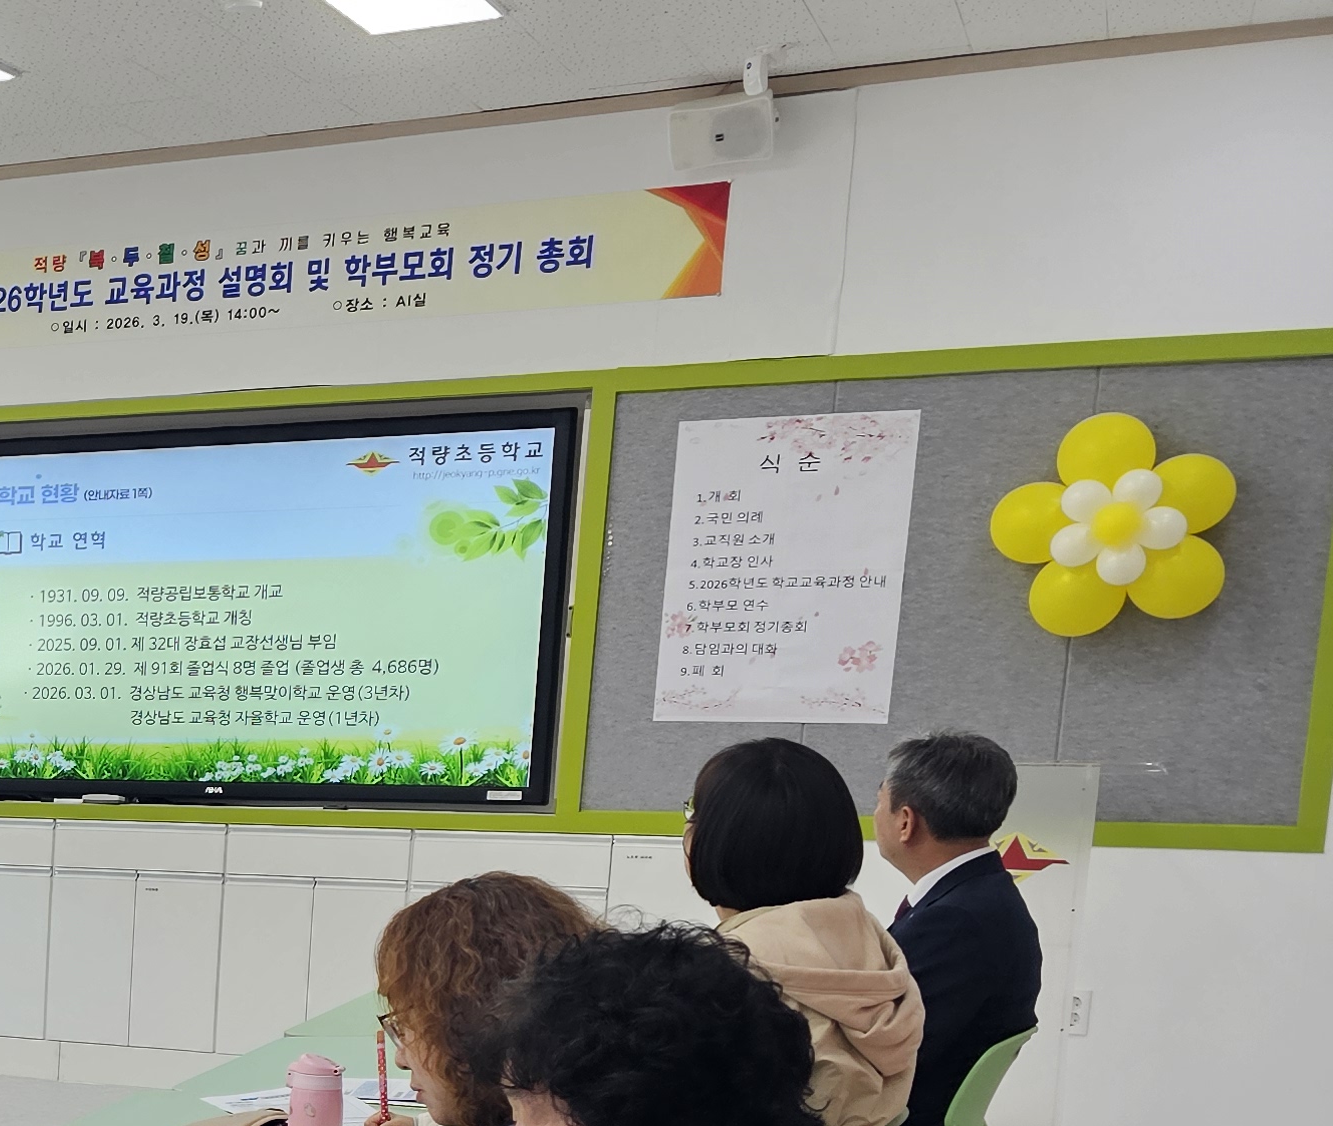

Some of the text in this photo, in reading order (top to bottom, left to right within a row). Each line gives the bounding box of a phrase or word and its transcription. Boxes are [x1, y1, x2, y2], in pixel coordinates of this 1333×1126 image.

[34, 255, 67, 273] 적량
[236, 240, 266, 255] 꿈과
[279, 235, 309, 252] 끼를
[323, 231, 369, 248] 키우는
[383, 222, 451, 242] 행복교육
[105, 268, 205, 306] 교육과정
[218, 260, 293, 299] 설명회
[308, 258, 330, 292] 및
[345, 247, 454, 287] 학부모회
[469, 241, 522, 279] 정기
[537, 235, 594, 273] 총회
[395, 292, 426, 308] AI실
[106, 316, 145, 330] 2026.
[152, 315, 165, 328] 3.
[174, 310, 219, 325] 19.(목)
[227, 307, 280, 321] 14:00~
[408, 442, 544, 465] 적량초등학교
[0, 483, 152, 505] 학교 현황 (안내자료 1쪽)
[737, 511, 763, 523] 의례
[31, 531, 105, 550] 학교 연혁
[749, 533, 775, 545] 소개
[748, 556, 773, 568] 인사
[773, 576, 854, 589] 학교교육과정
[860, 575, 886, 588] 안내
[41, 584, 283, 603] 1931. 09. 09. 적량공립보통학교 개교
[743, 599, 769, 611] 연수
[39, 610, 252, 627] 1996. 03. 01. 적량초등학교 개칭
[38, 633, 337, 651] 2025. 09. 01. 제 32대 장효섭 교장선생님 부임
[752, 643, 777, 655] 대화
[37, 658, 439, 676] 2026. 01. 29. 제 91회 졸업식 8명 졸업 (졸업생 총 4,686명)
[32, 687, 70, 700] 2026.
[75, 686, 95, 700] 03.
[100, 686, 121, 700] 01.
[130, 686, 184, 701] 경상남도
[188, 686, 230, 701] 교육청
[131, 710, 185, 726] 경상남도
[189, 710, 231, 726] 교육청
[235, 711, 293, 726] 자율학교
